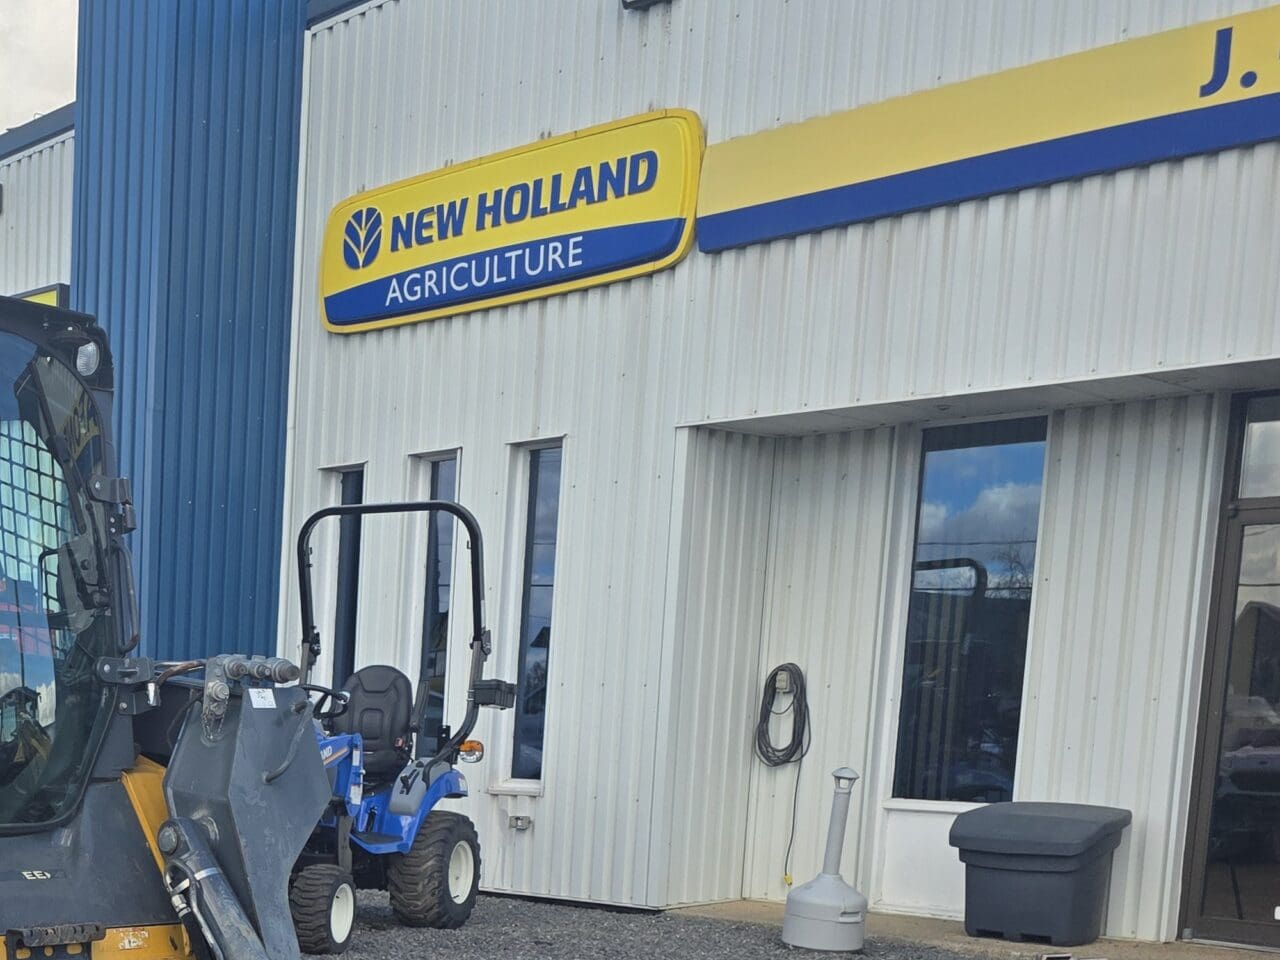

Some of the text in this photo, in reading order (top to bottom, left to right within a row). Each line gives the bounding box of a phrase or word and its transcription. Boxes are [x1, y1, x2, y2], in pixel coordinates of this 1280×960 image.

[1199, 27, 1257, 98] J.
[390, 150, 658, 252] NEW HOLLAND
[385, 236, 583, 306] AGRICULTURE
